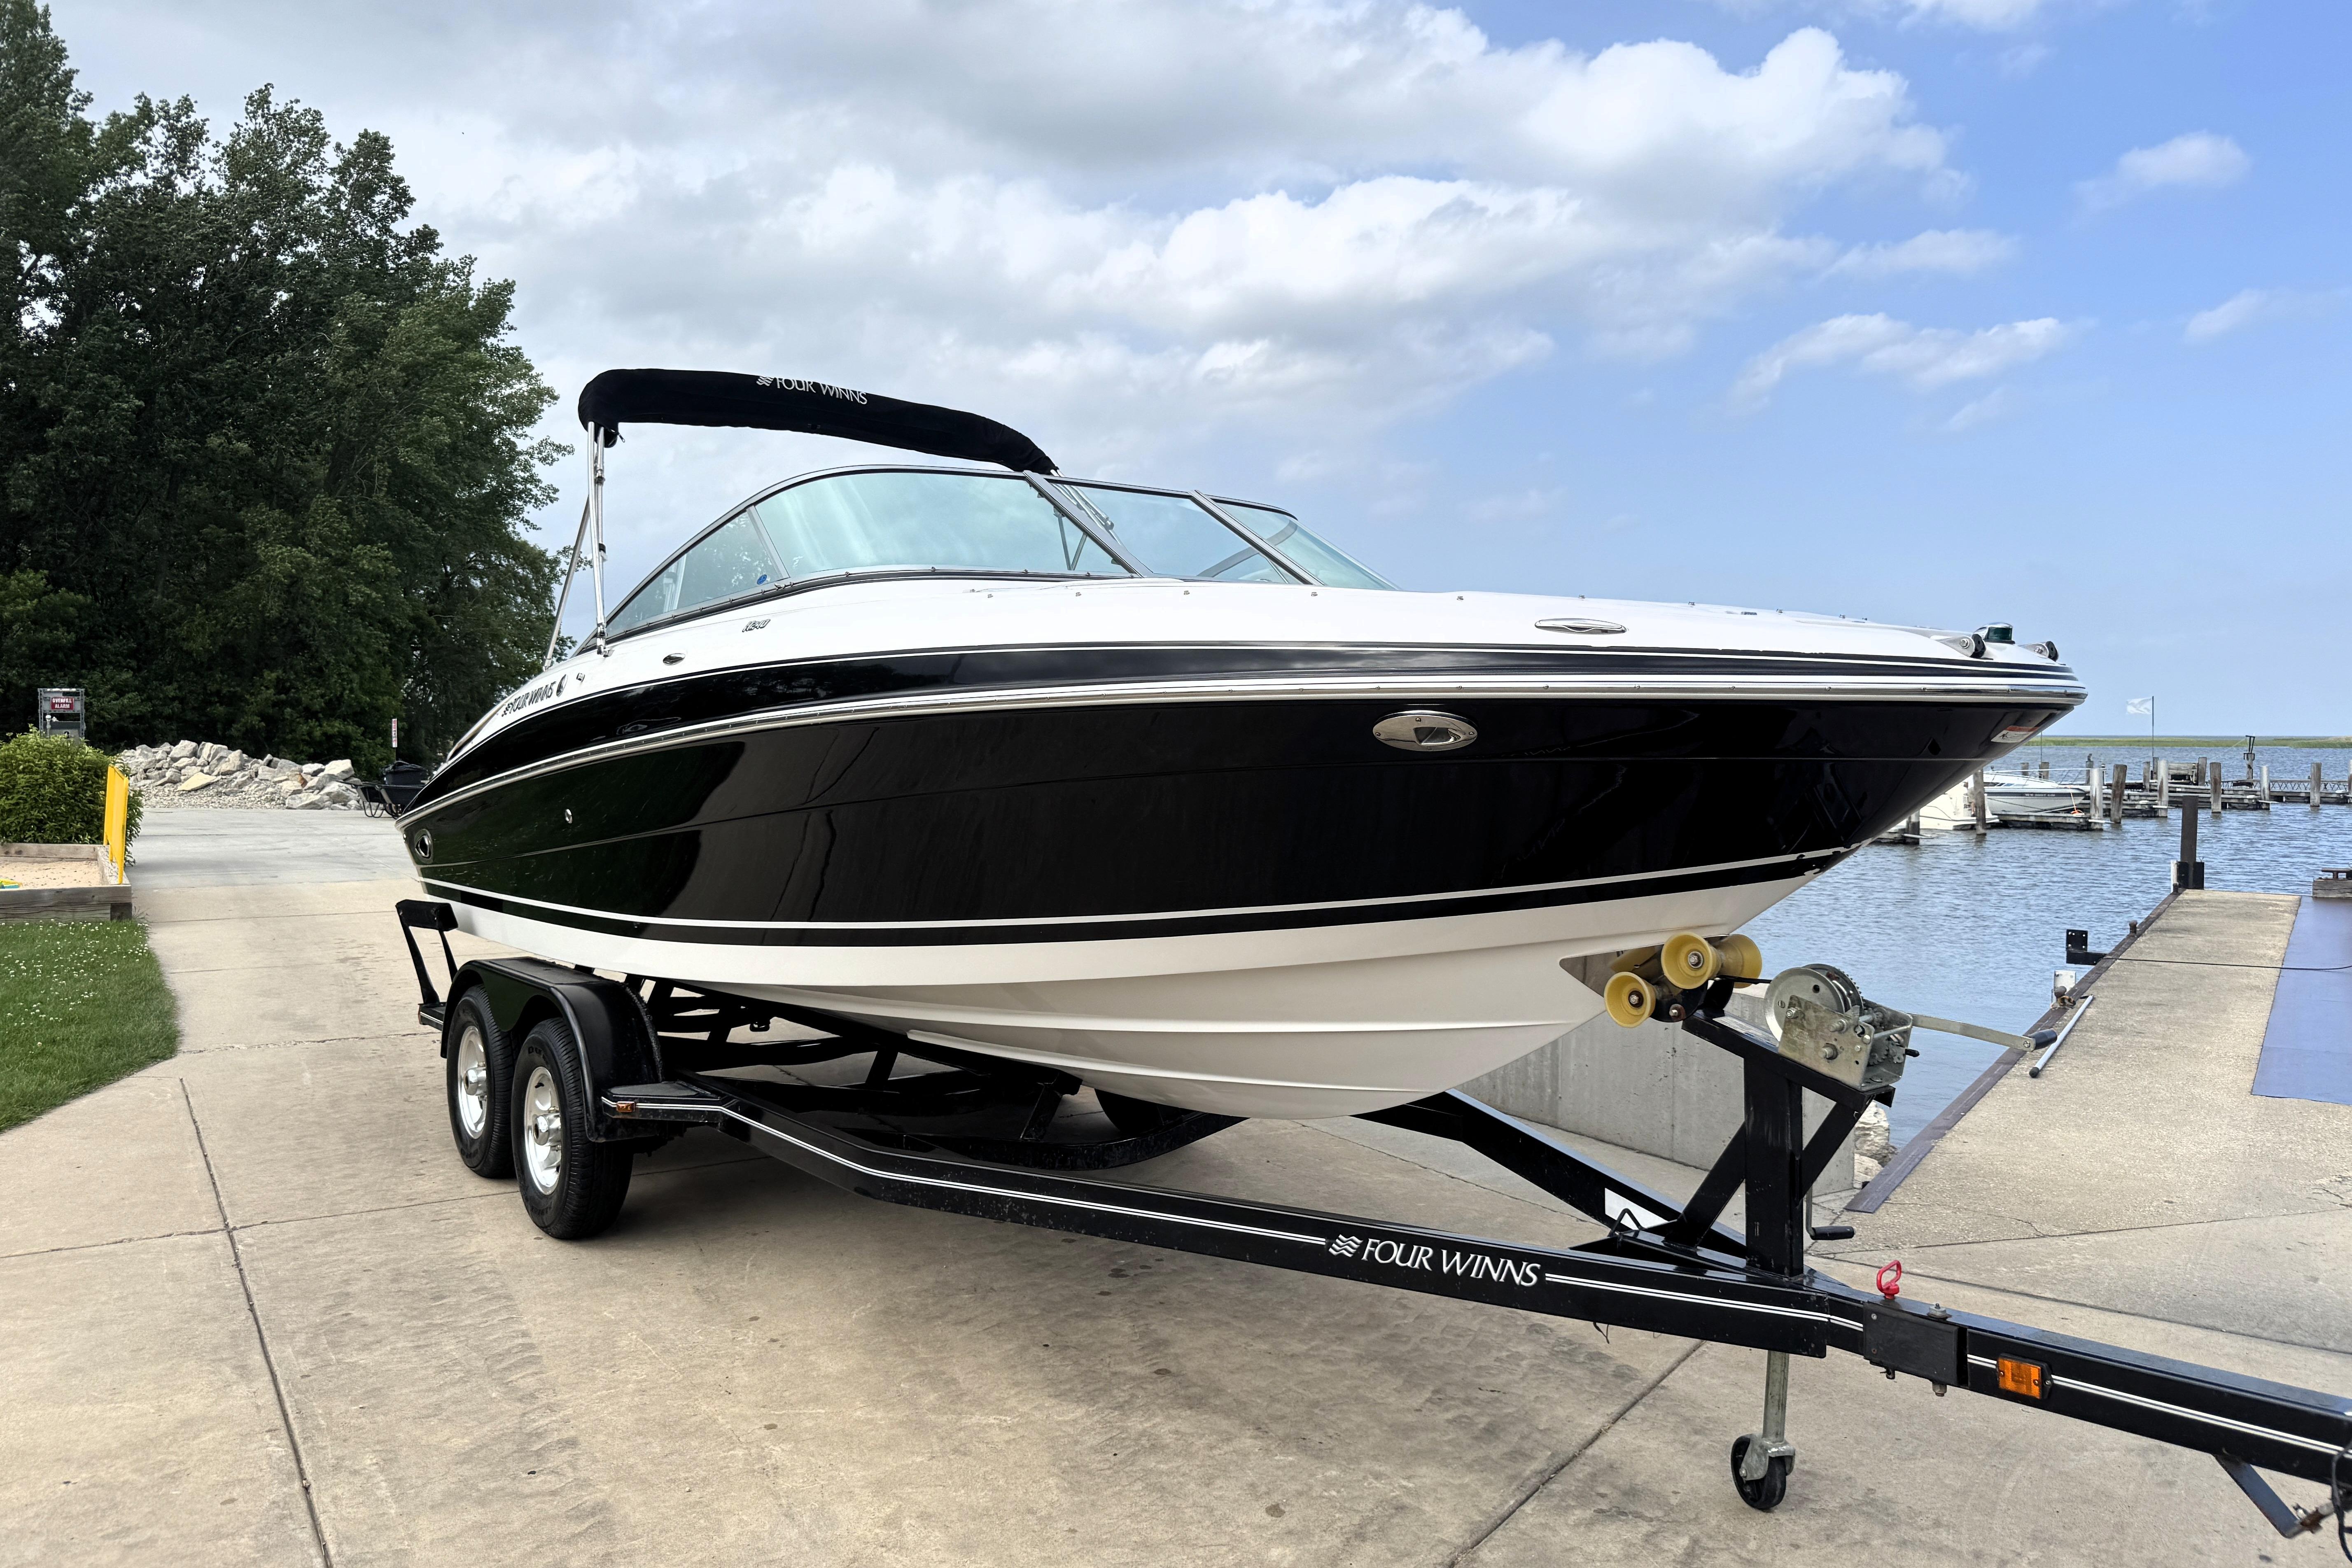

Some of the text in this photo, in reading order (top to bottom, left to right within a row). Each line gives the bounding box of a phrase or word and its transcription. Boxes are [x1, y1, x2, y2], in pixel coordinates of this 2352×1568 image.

[776, 378, 867, 404] FOUR WINNS
[1362, 1238, 1540, 1287] FOUR WINNS
